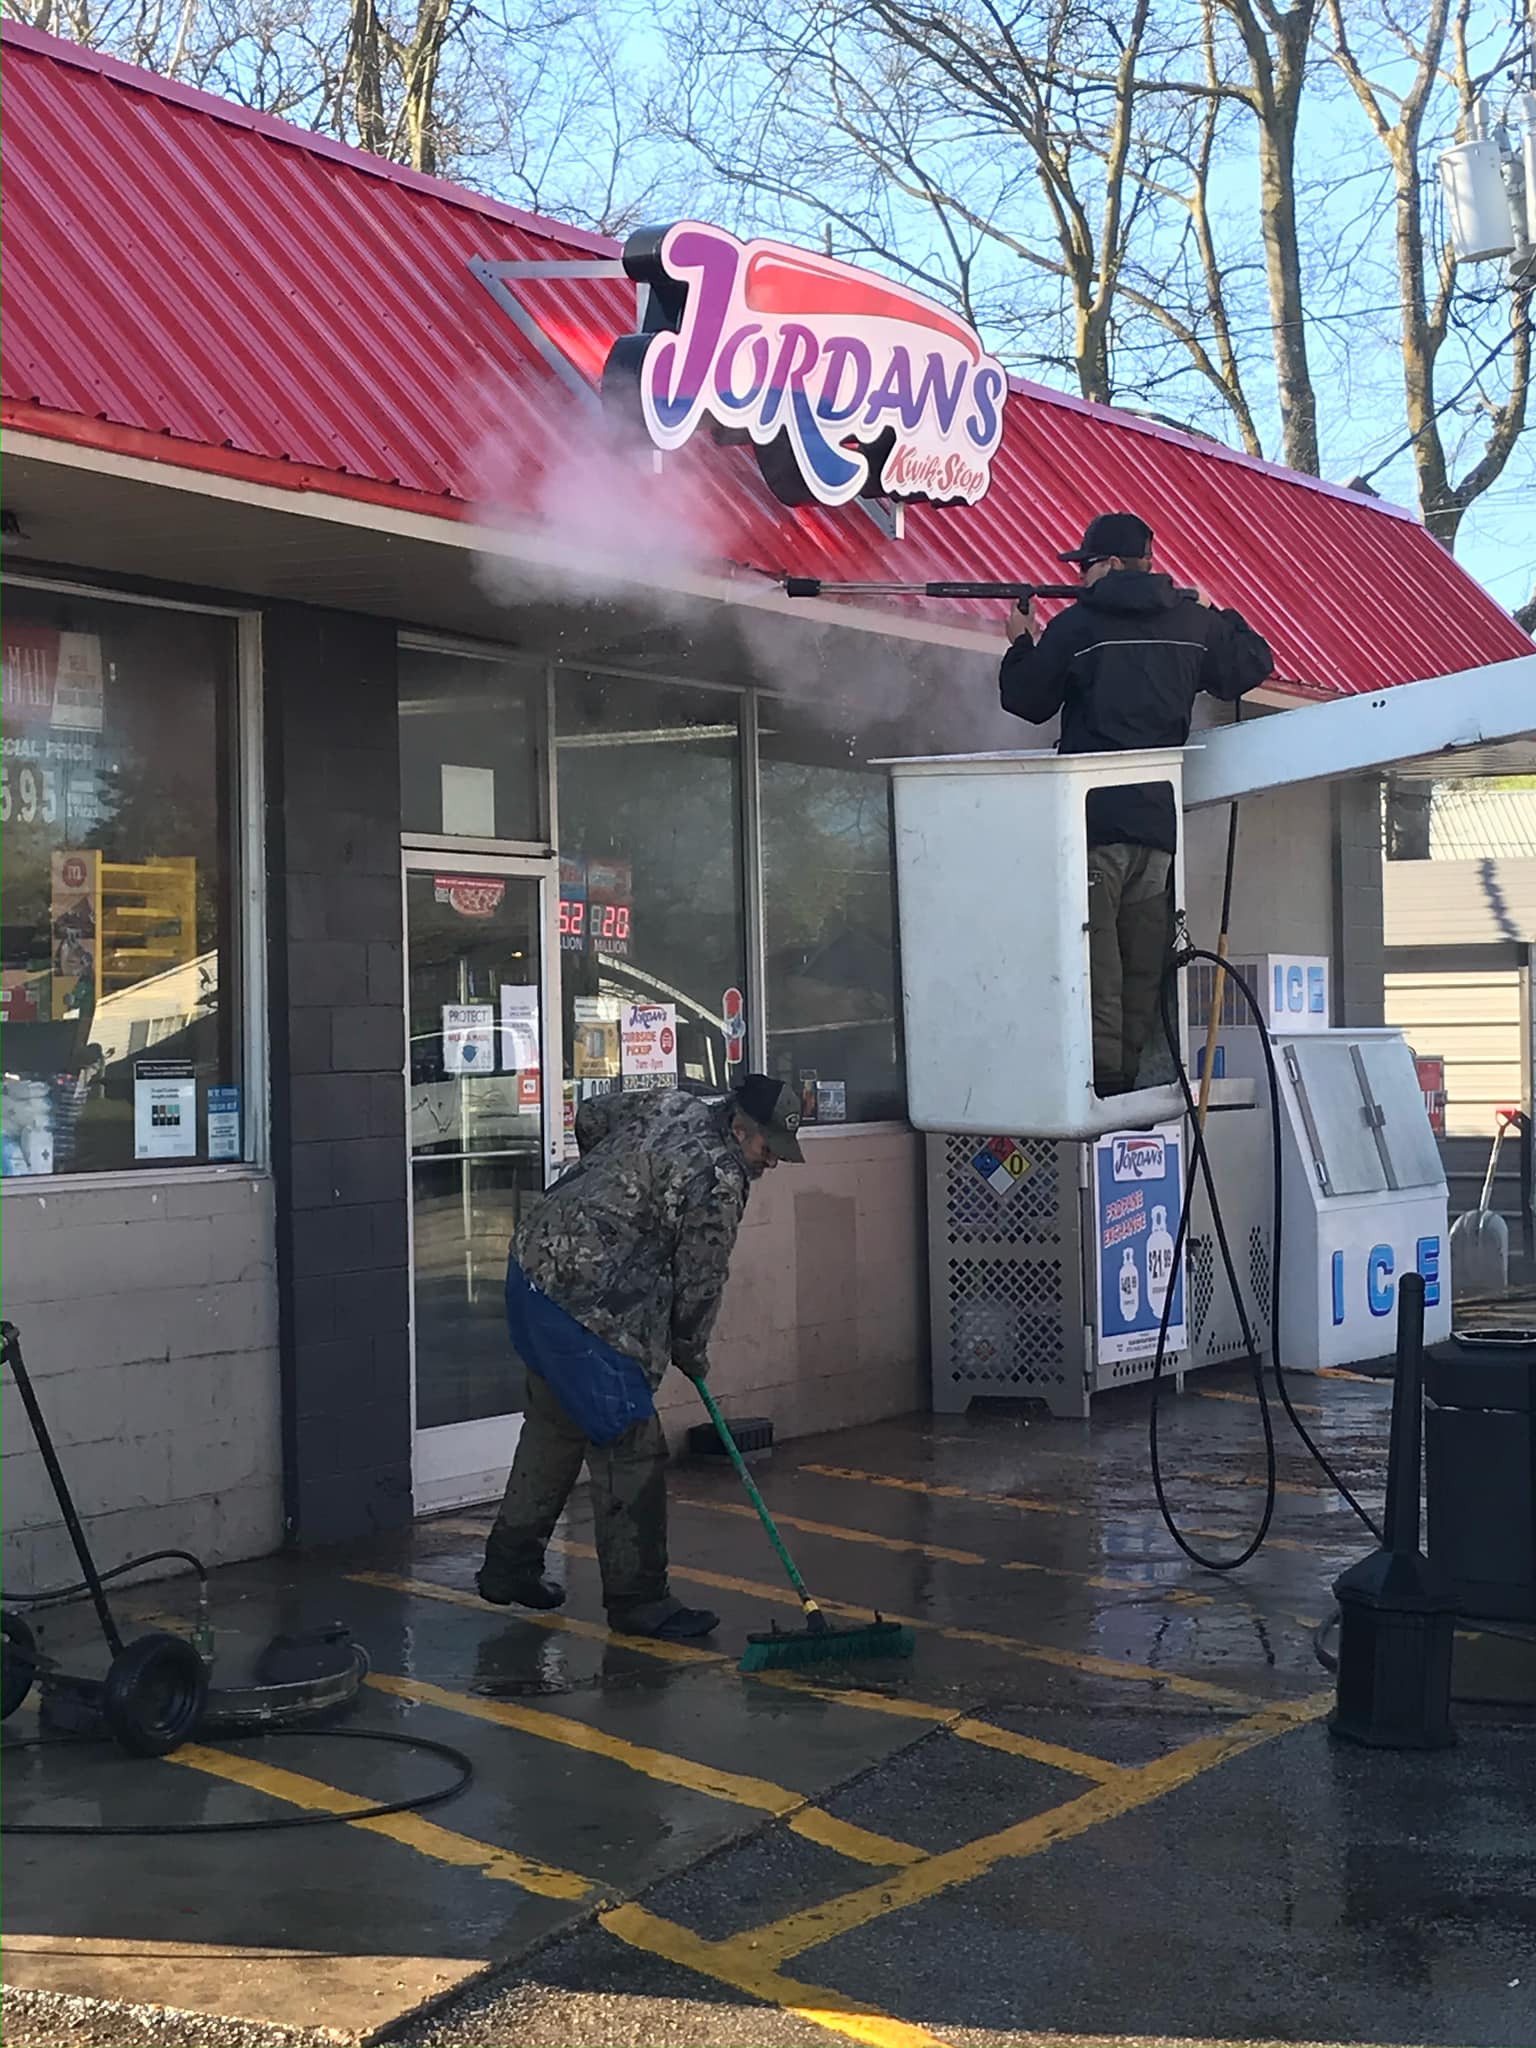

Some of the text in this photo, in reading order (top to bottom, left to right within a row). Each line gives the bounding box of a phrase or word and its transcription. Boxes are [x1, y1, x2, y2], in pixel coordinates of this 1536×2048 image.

[594, 938, 628, 955] MILLION
[1273, 963, 1324, 1014] ICE
[449, 1009, 488, 1023] PROTECT
[1010, 1154, 1023, 1175] 0
[1332, 1236, 1440, 1326] ICE
